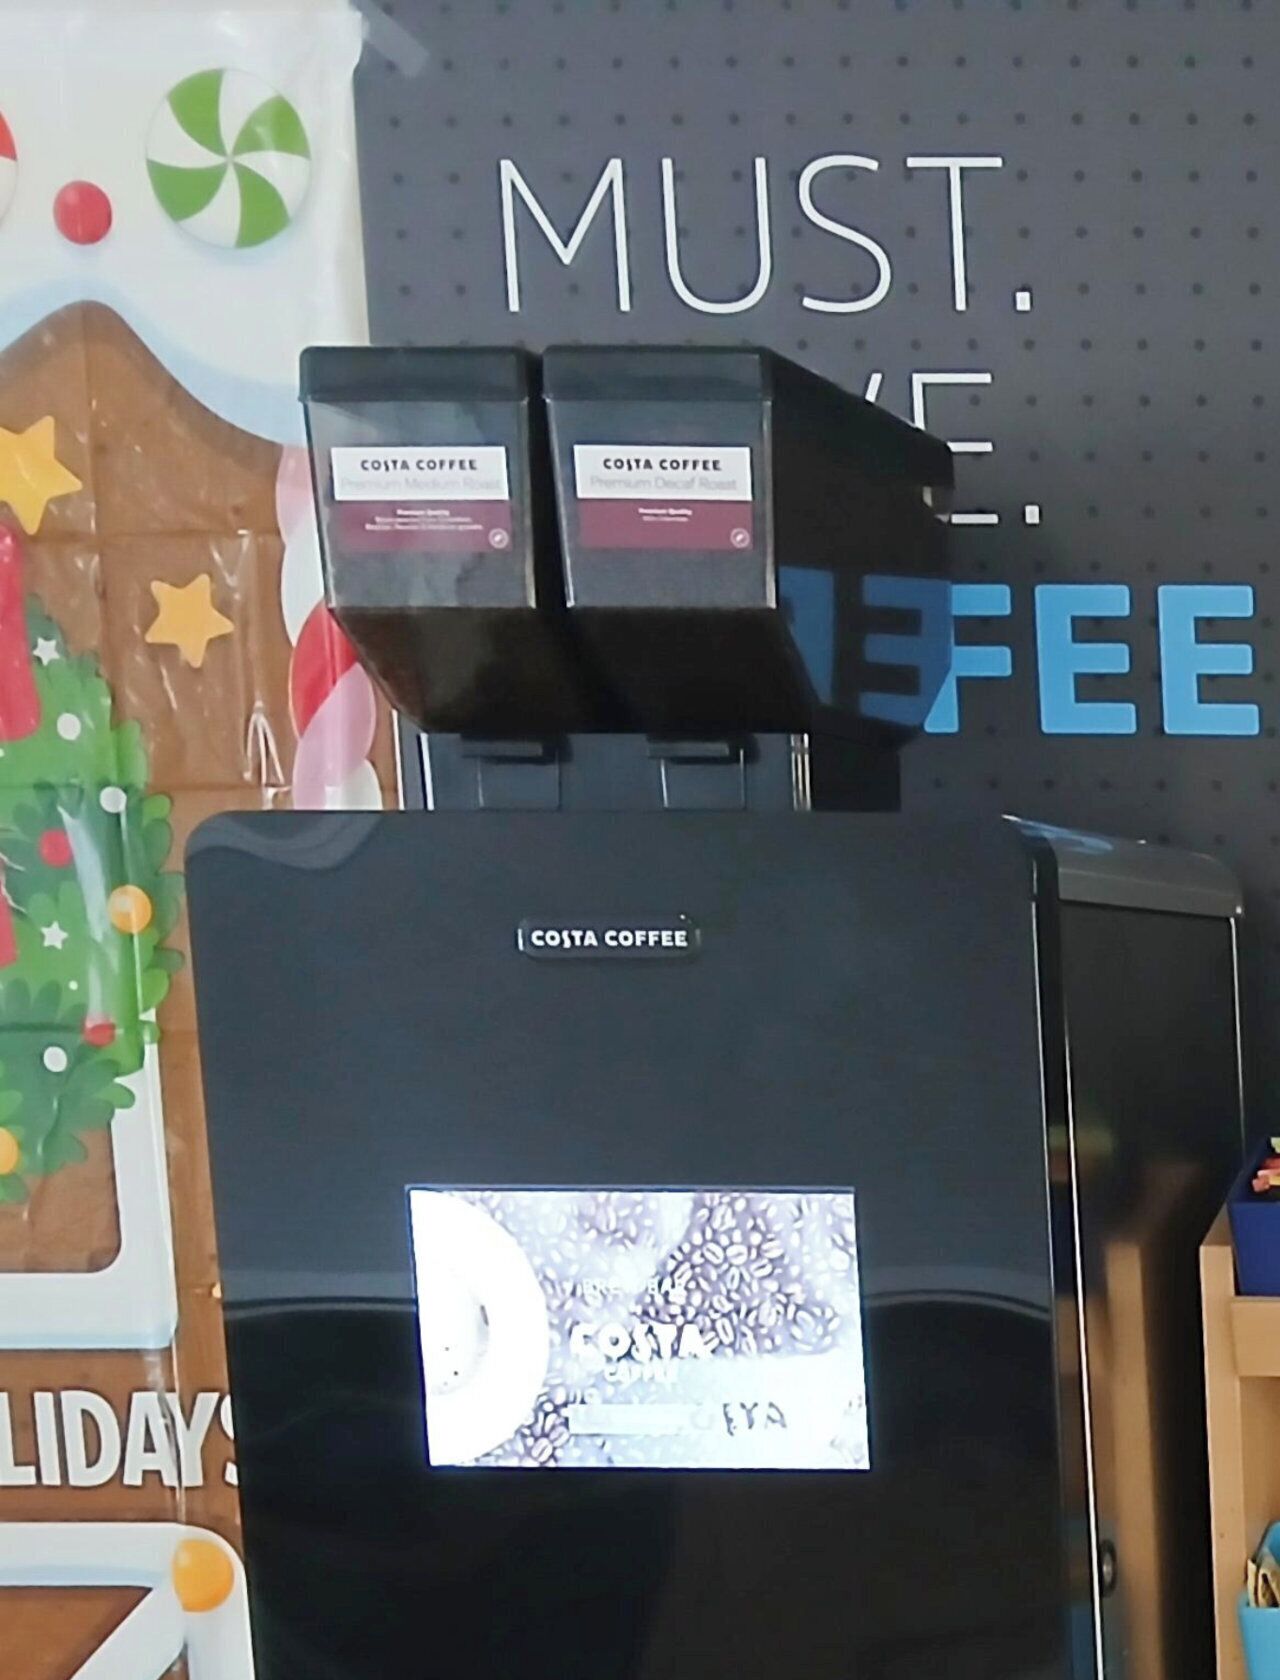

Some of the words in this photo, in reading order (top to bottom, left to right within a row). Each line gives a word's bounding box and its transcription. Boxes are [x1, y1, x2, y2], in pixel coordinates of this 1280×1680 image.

[500, 154, 1032, 314] MUST.
[361, 459, 410, 472] COSTA
[415, 459, 478, 471] COFFEE
[603, 458, 653, 471] COSTA
[659, 459, 722, 471] COFFEE
[531, 930, 598, 948] COSTA
[604, 930, 688, 947] COFFEE
[570, 1323, 704, 1360] COSTA
